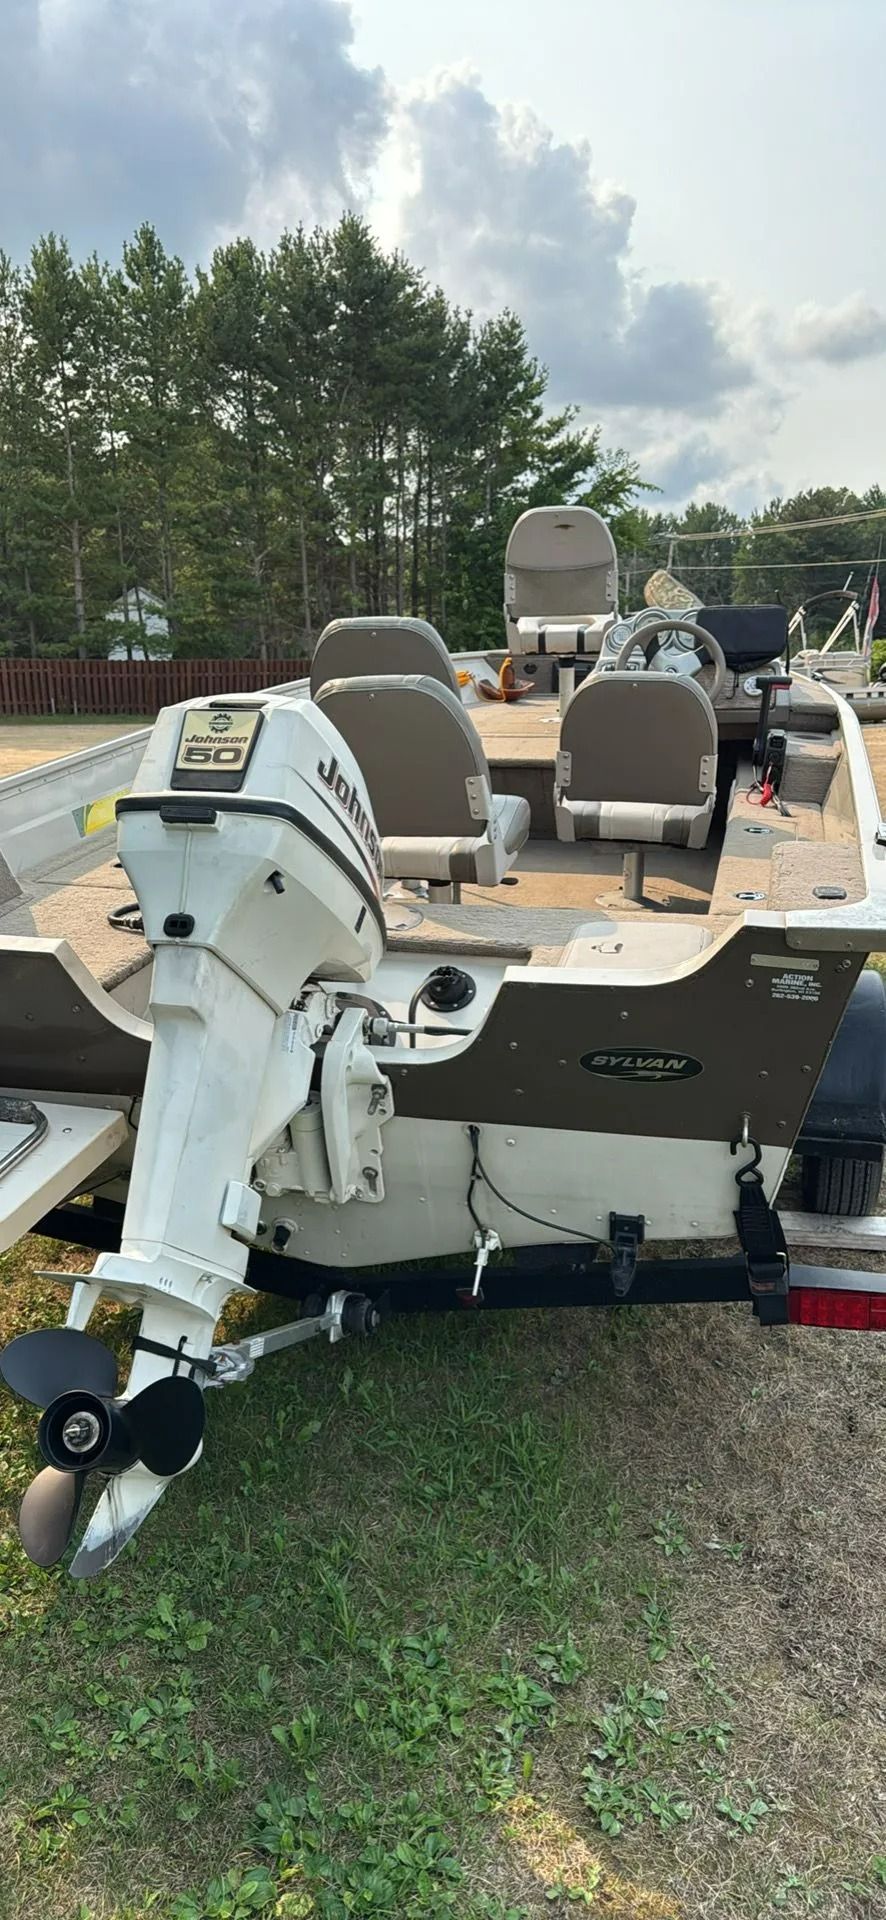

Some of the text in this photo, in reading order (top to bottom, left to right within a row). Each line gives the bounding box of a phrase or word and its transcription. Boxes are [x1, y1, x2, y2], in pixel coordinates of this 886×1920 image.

[185, 734, 249, 744] Johnson
[182, 745, 244, 764] 50
[782, 973, 814, 982] ACTION
[591, 1056, 688, 1069] SYLVAN
